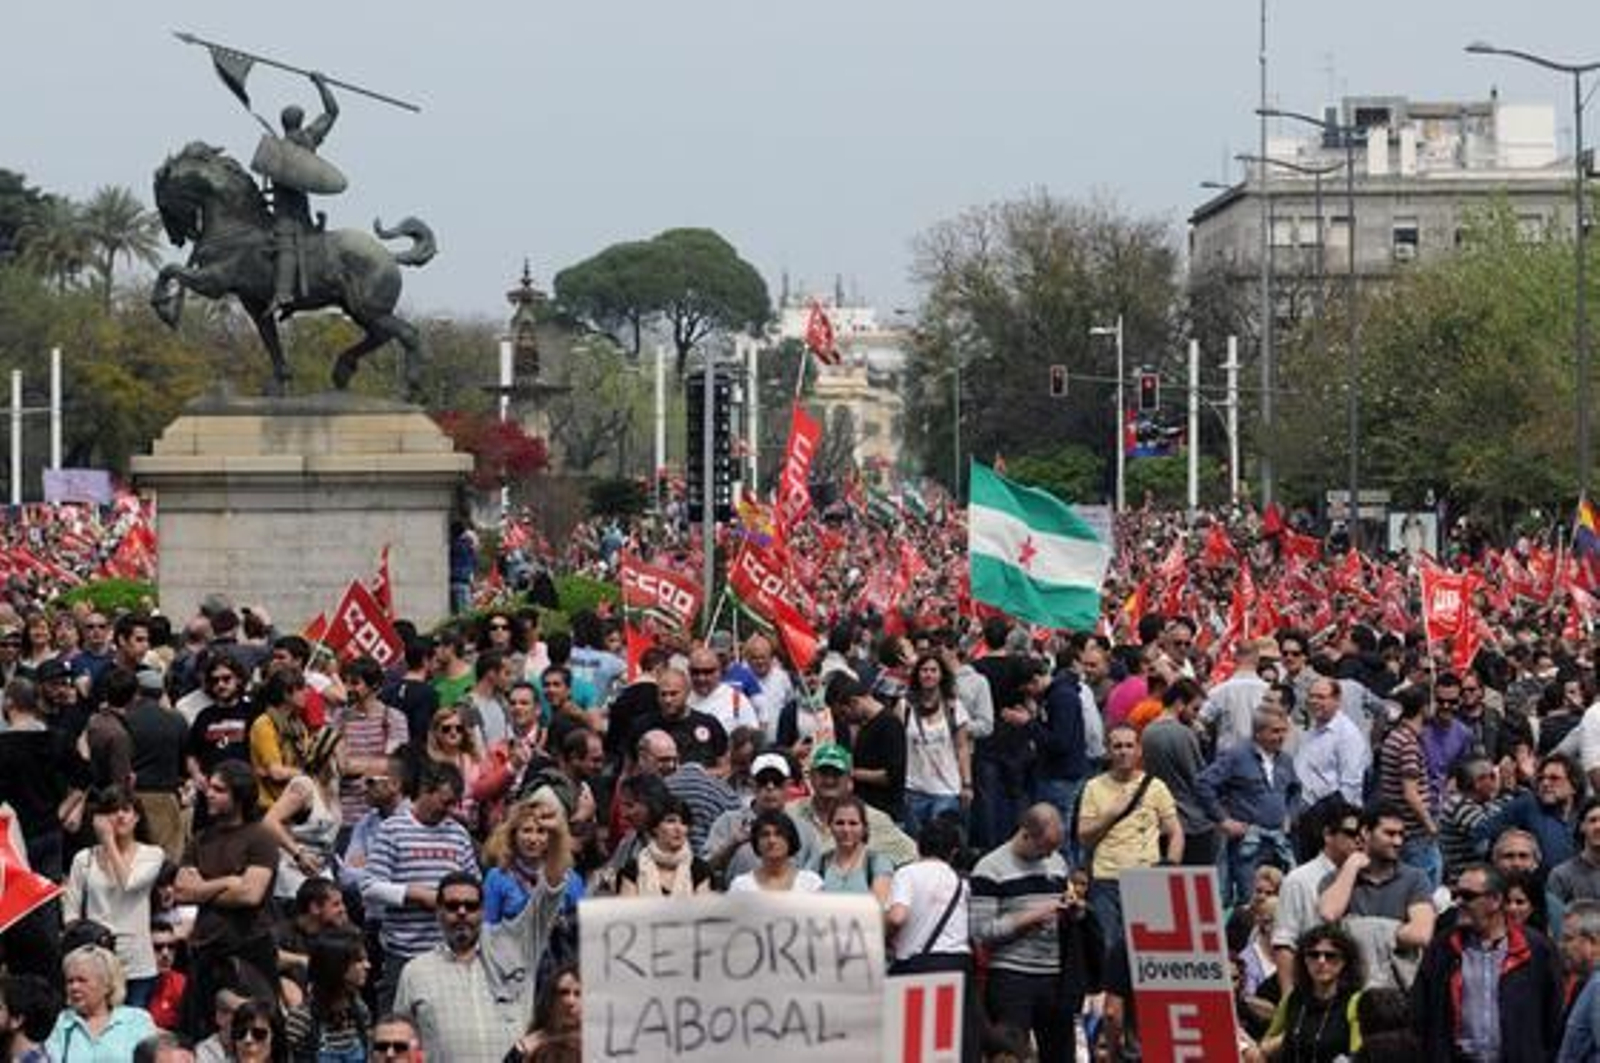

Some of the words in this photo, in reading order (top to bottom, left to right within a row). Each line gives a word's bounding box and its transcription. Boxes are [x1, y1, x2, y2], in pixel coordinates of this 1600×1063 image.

[1130, 874, 1220, 953] J!
[603, 917, 873, 988] REFORMA
[1138, 955, 1222, 983] jóvenes
[604, 996, 847, 1057] LABORAL
